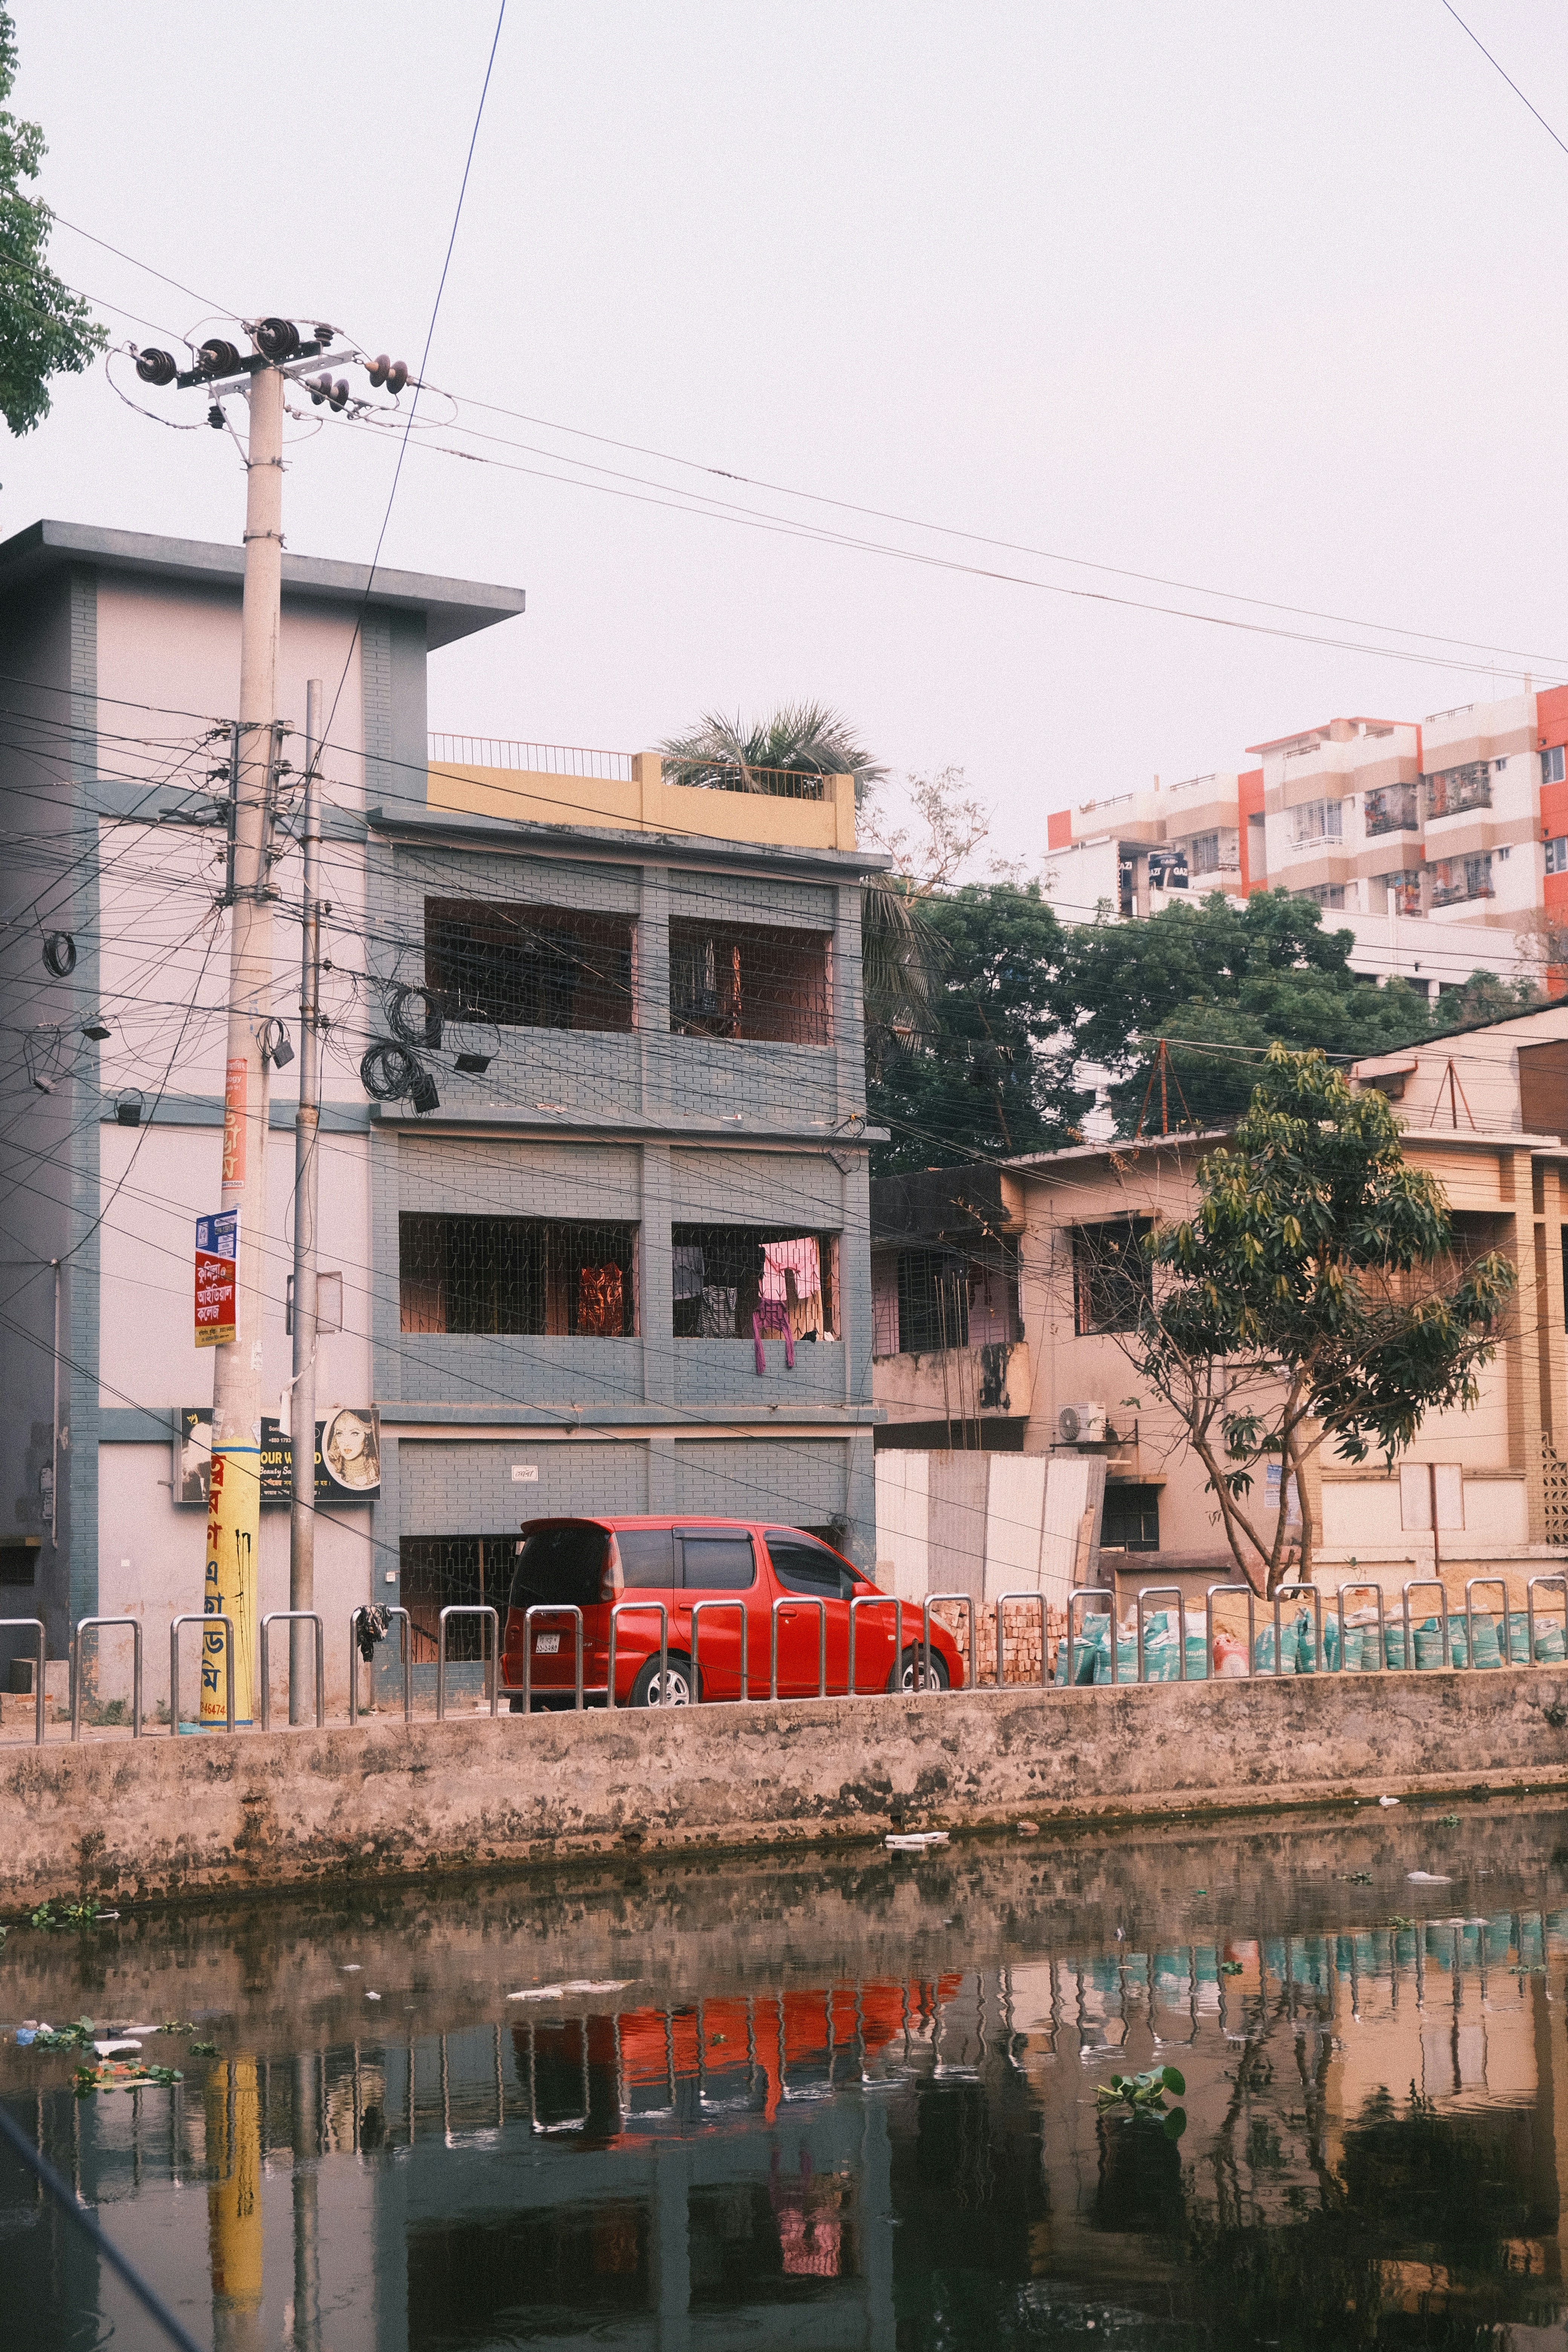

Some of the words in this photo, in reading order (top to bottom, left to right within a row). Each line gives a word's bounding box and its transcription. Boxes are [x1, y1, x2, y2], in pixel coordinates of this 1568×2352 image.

[1119, 861, 1132, 870] AZI
[1148, 867, 1162, 877] AZI
[197, 1261, 221, 1284] কুমিল্লা
[197, 1283, 233, 1305] আইডিয়াল
[197, 1305, 219, 1321] কলেজ
